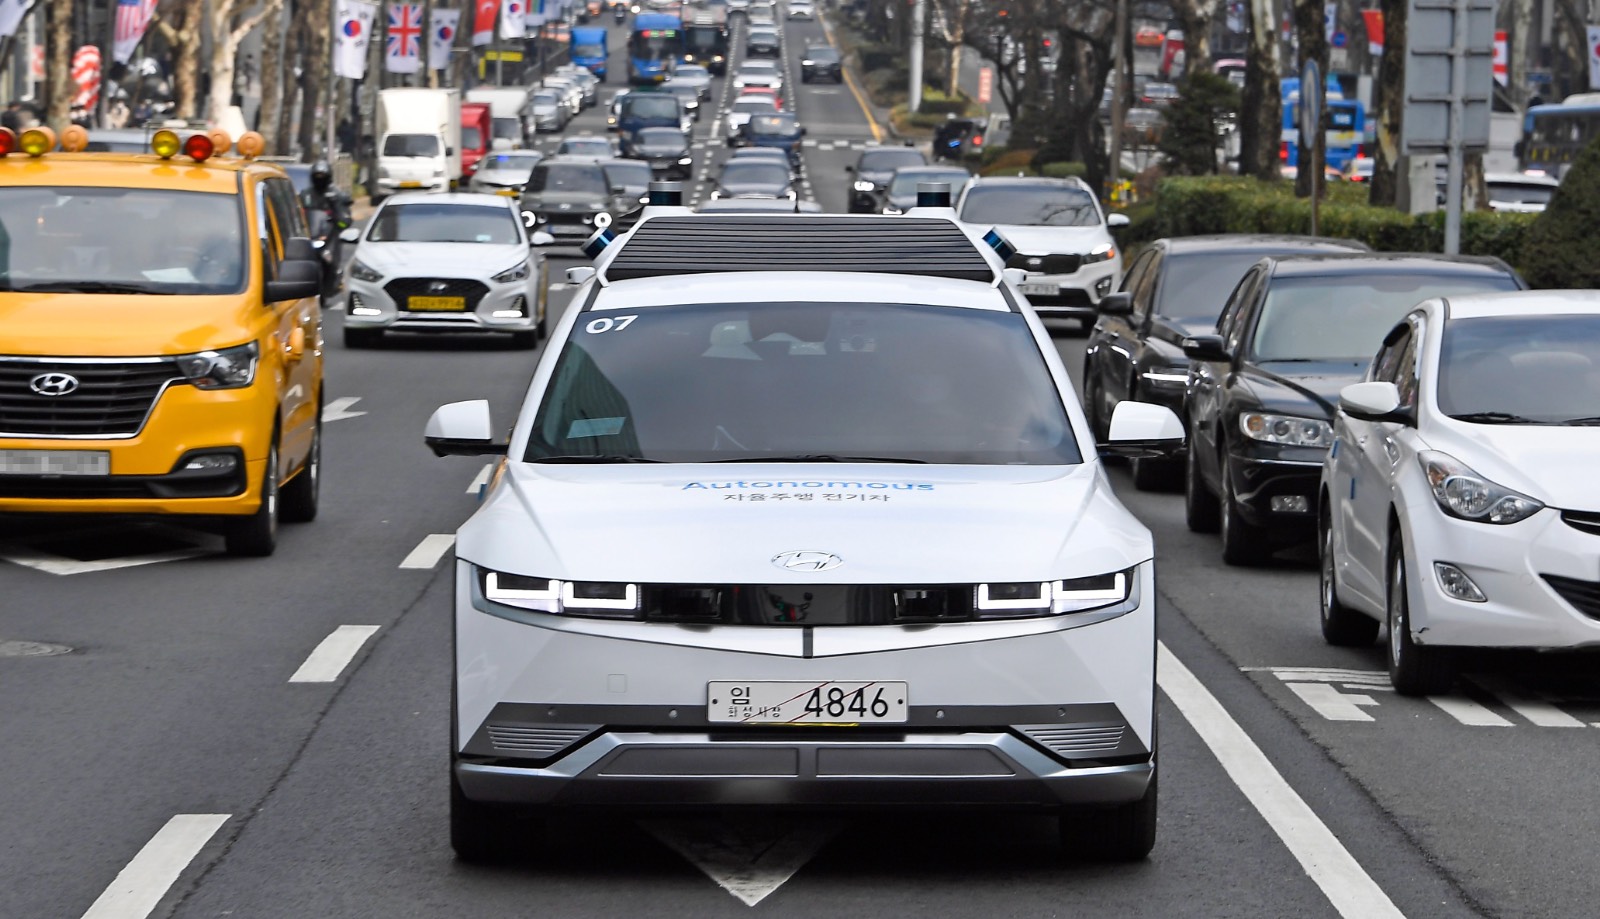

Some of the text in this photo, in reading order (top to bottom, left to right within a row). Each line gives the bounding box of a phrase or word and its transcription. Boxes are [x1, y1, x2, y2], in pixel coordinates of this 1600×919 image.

[585, 315, 638, 334] 07
[682, 480, 935, 492] Autonomous
[723, 493, 891, 503] 자율주행 전기차
[731, 687, 750, 705] 임
[804, 687, 888, 718] 4846
